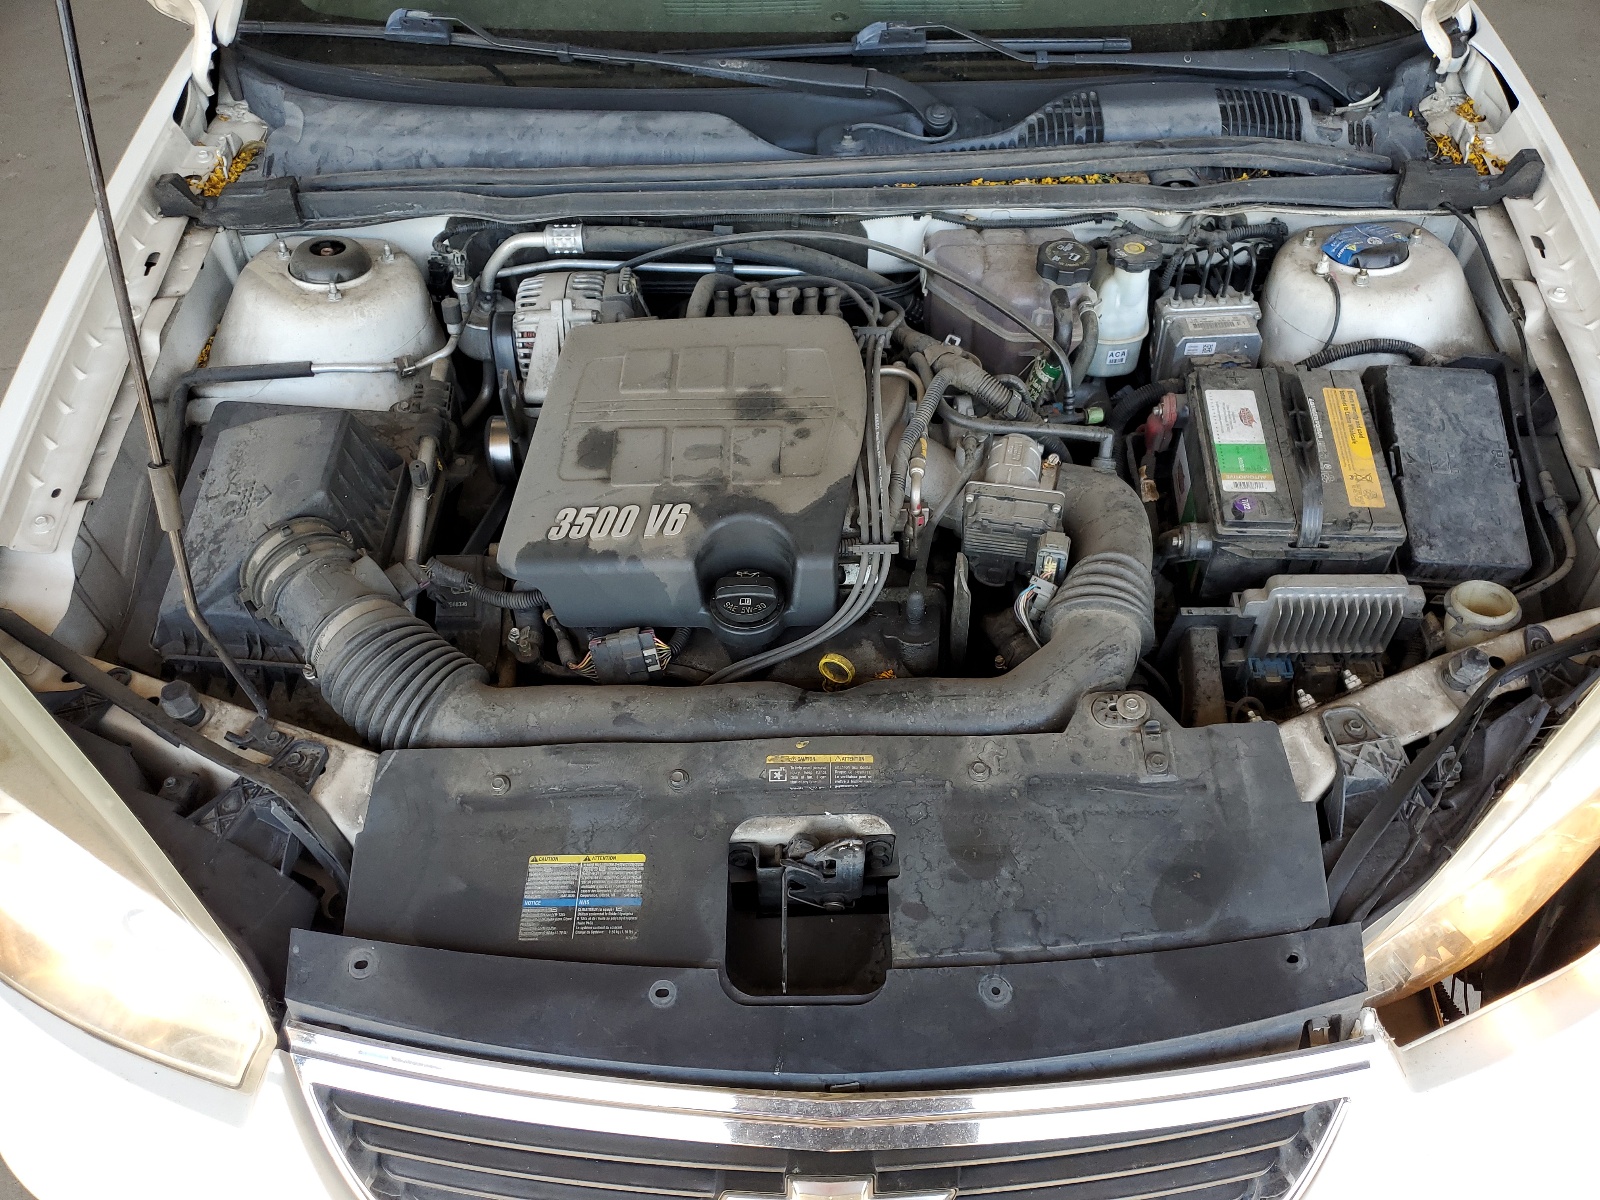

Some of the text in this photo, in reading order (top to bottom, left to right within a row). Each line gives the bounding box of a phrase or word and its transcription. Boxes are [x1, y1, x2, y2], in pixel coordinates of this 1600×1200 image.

[547, 503, 692, 540] 3500 V6
[723, 601, 767, 614] SAE 5W-30
